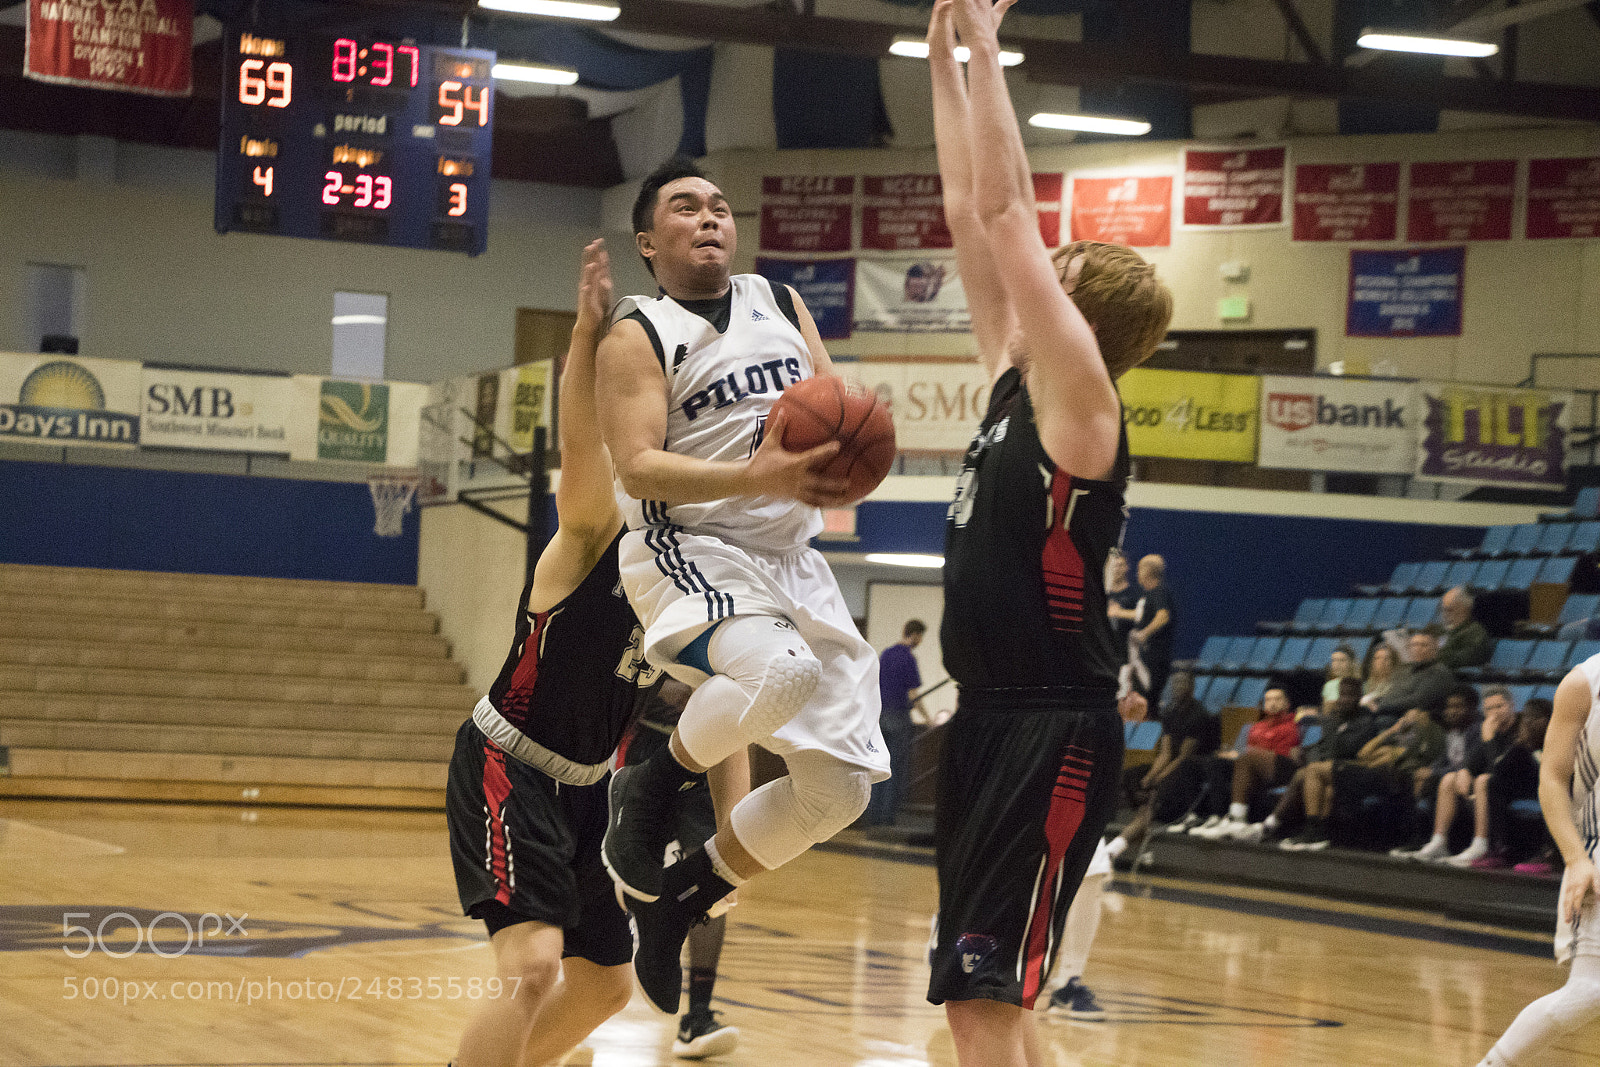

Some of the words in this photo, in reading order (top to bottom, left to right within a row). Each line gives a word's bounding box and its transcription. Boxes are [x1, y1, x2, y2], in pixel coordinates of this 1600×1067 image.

[40, 2, 98, 28] NATIONAL
[73, 23, 141, 48] CHAMPION
[73, 44, 133, 65] DIVISION
[332, 38, 419, 87] 8:37
[239, 59, 292, 108] 69
[439, 81, 489, 127] 54
[334, 115, 387, 134] period
[253, 166, 274, 197] 4
[322, 171, 393, 210] 2-33
[448, 183, 468, 217] 3
[147, 384, 235, 419] SMB
[681, 357, 801, 421] PILOTS
[78, 414, 132, 440] Inn
[1122, 406, 1161, 427] OOD
[1317, 395, 1406, 428] bank
[1442, 448, 1549, 476] Studio
